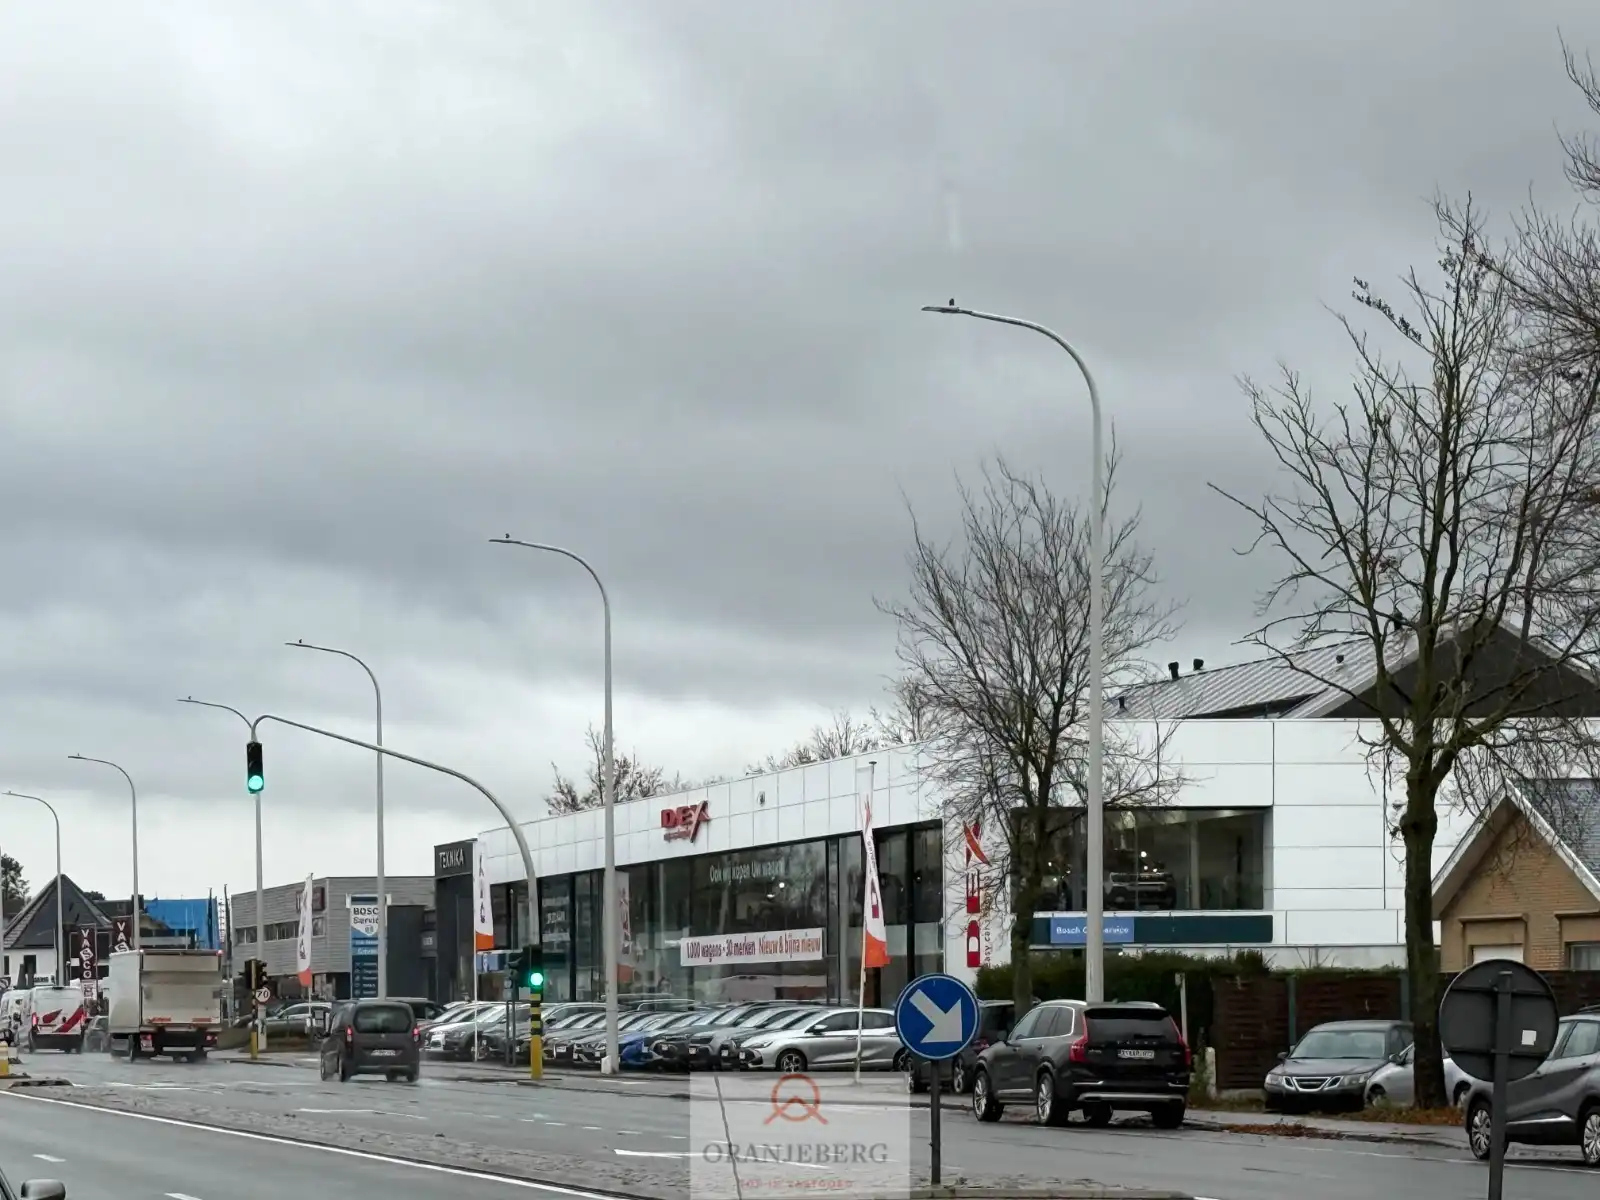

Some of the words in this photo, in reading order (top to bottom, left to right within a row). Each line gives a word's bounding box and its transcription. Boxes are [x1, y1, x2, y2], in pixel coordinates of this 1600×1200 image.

[661, 800, 710, 843] DEX
[439, 848, 464, 869] TEXNIKA
[963, 820, 991, 968] DEX
[353, 907, 379, 915] BOSC
[115, 921, 129, 953] VAS
[1056, 926, 1081, 934] Bosch
[1103, 926, 1129, 934] ervice
[80, 929, 94, 979] VASCO
[733, 936, 756, 956] merken
[758, 935, 779, 955] Nieuw
[256, 988, 269, 999] 70
